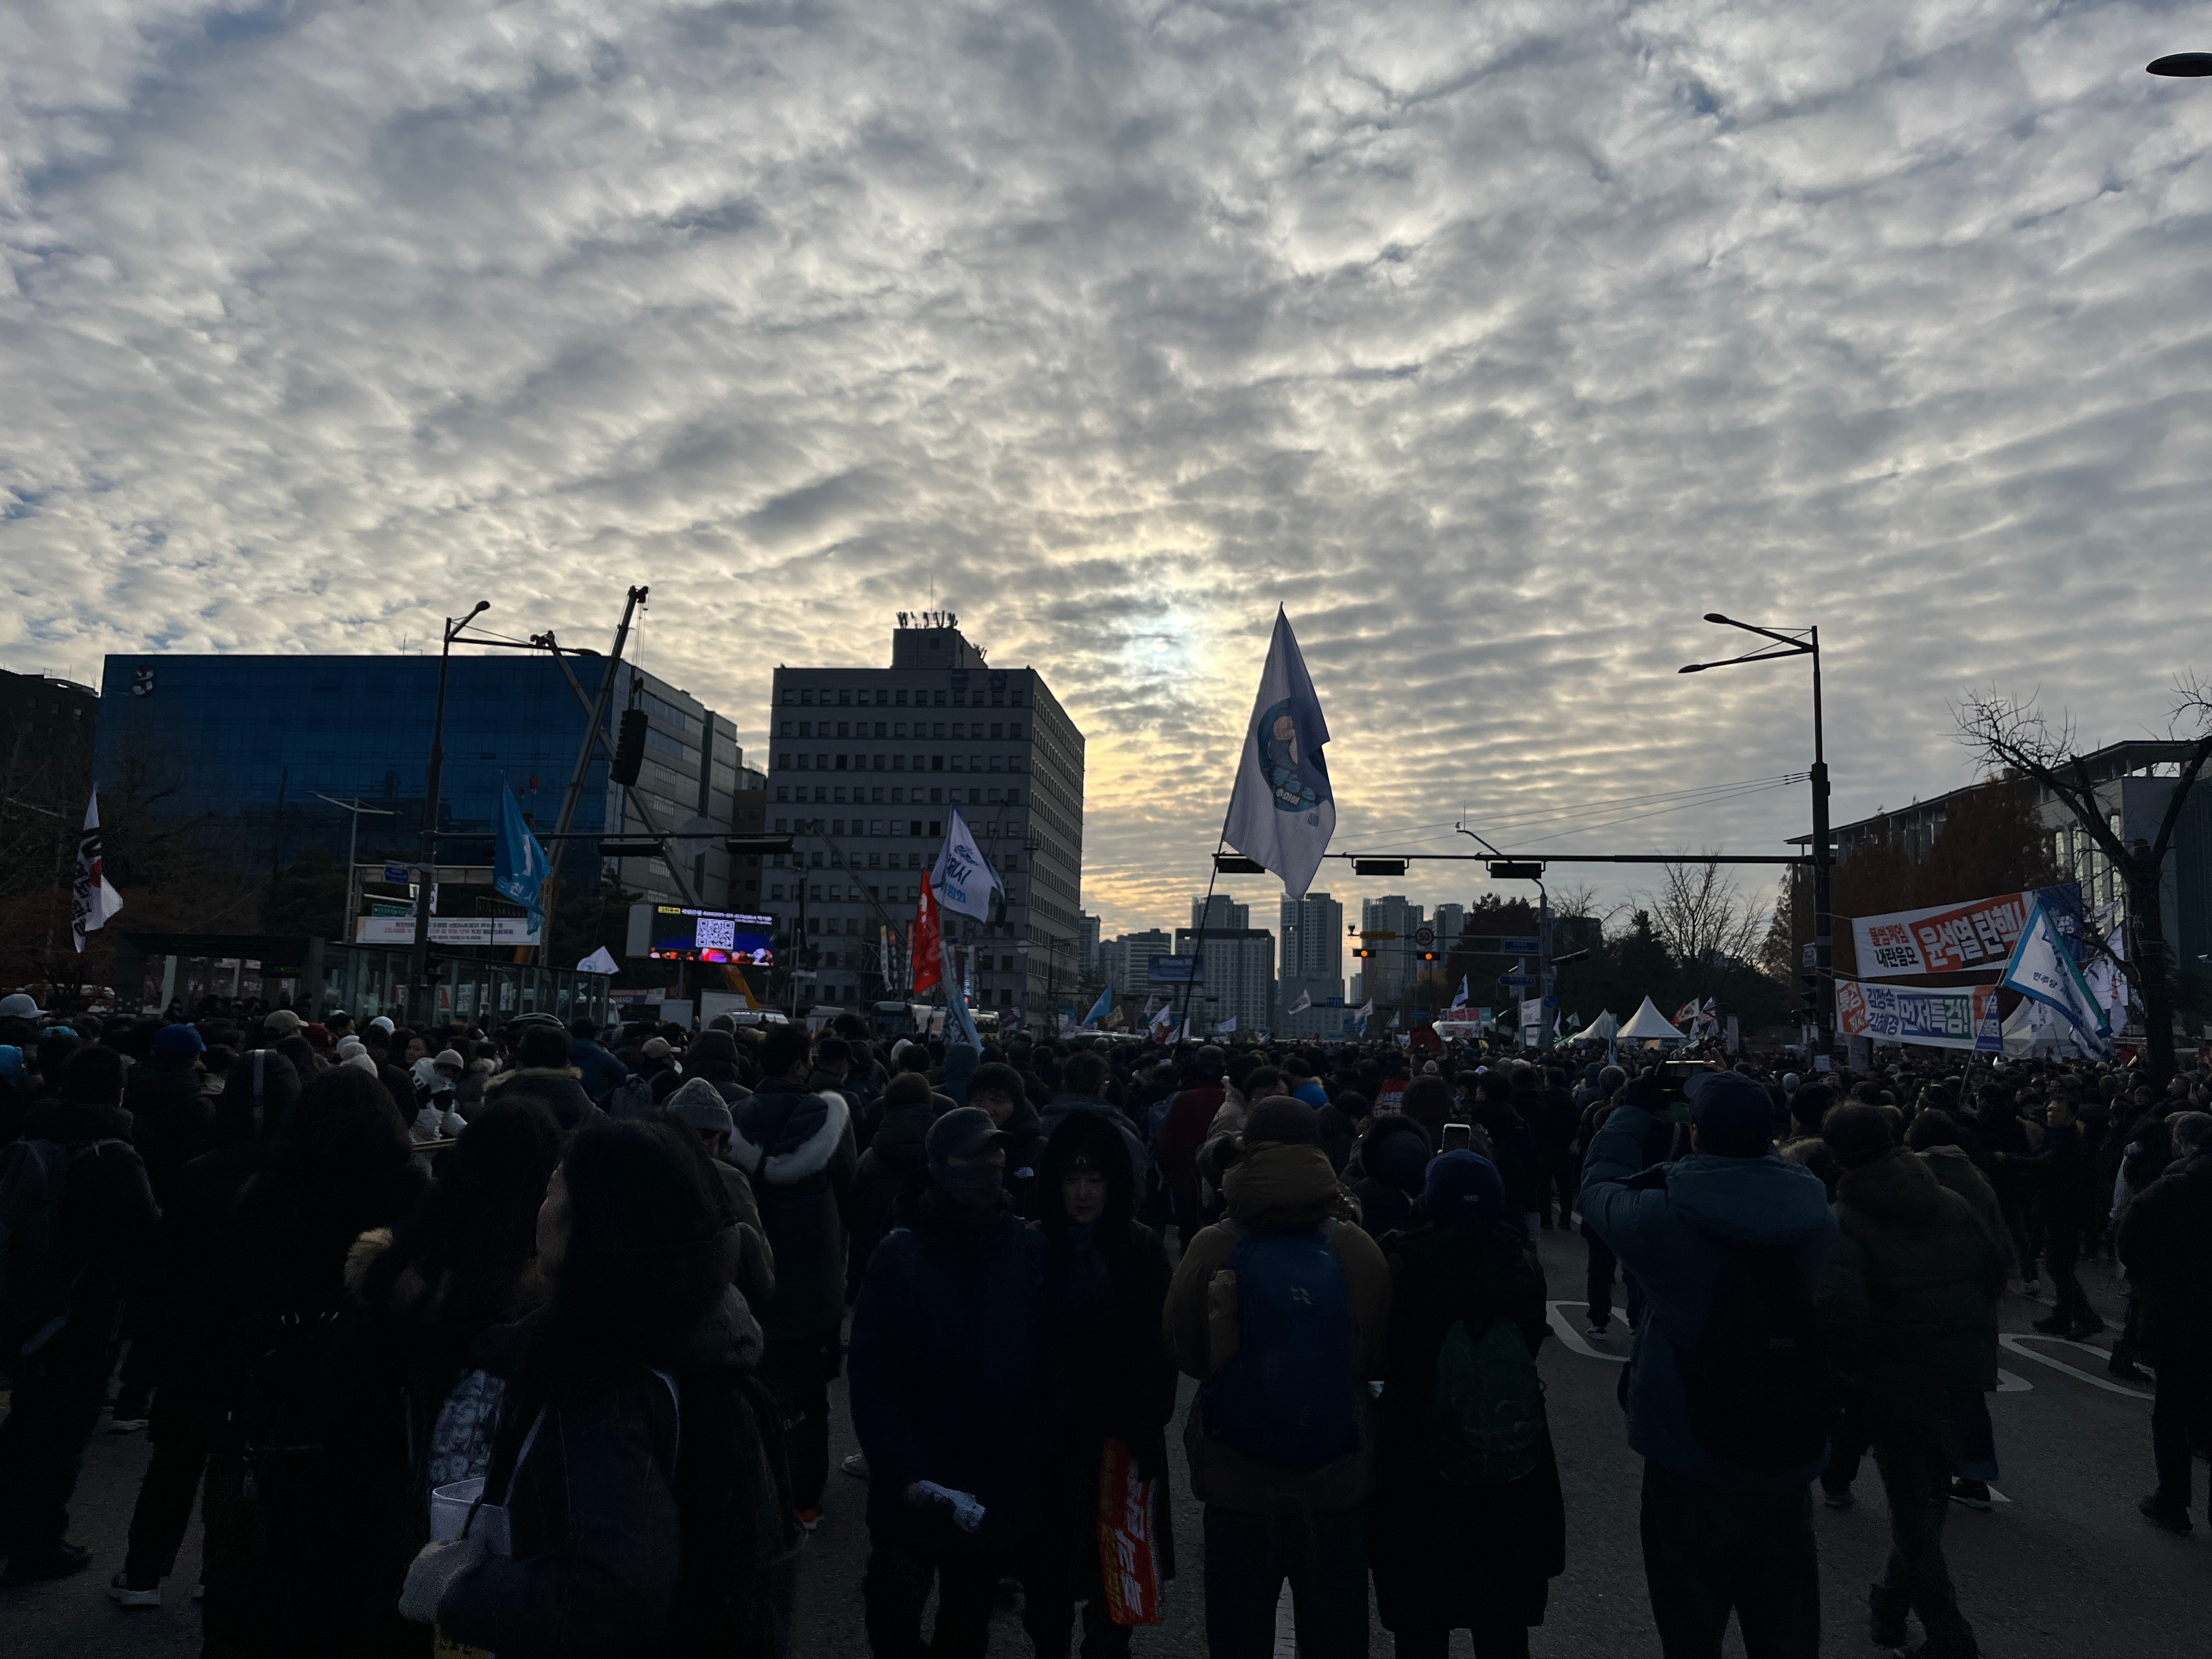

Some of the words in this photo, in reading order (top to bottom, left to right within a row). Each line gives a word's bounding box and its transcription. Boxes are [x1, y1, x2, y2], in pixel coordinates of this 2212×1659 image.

[1419, 933, 1430, 941] 50
[1918, 916, 1984, 968] 윤석열
[1875, 946, 1918, 968] 내란음모
[2033, 972, 2058, 989] 민주당
[1866, 988, 1895, 1010] 김정숙
[1867, 1012, 1899, 1036] 김혜경
